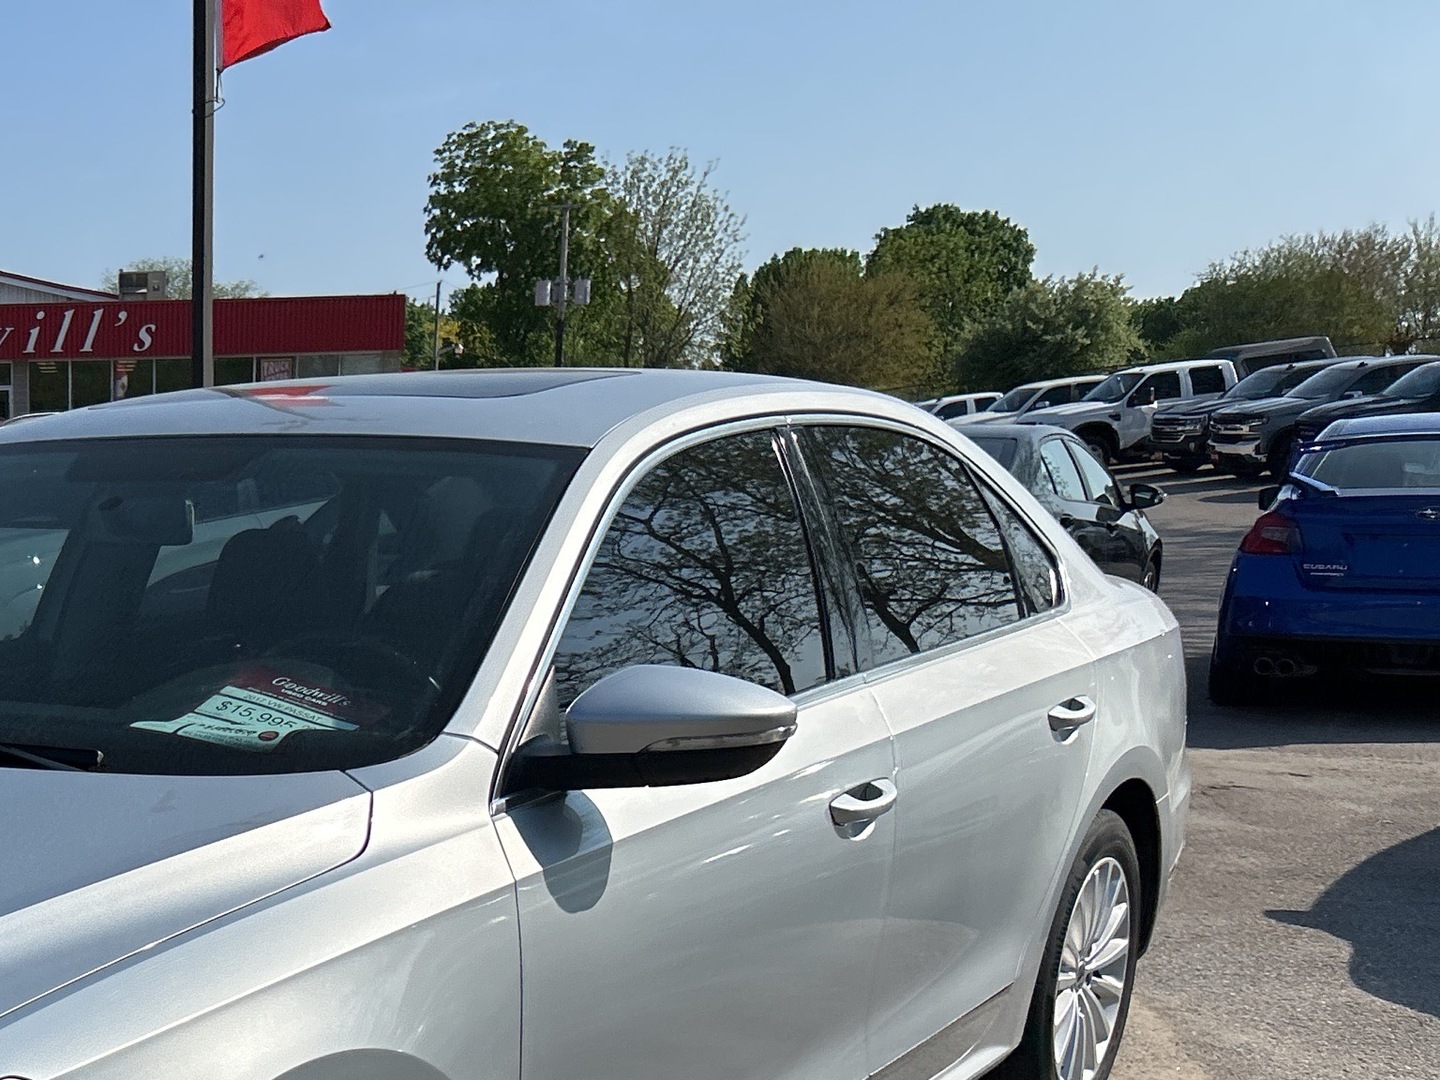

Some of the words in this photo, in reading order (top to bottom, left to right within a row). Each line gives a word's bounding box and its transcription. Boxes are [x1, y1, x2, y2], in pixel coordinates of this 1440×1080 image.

[271, 676, 352, 707] Goodwill's
[304, 695, 328, 707] CARS
[216, 700, 298, 729] $15,995
[243, 694, 267, 704] 2017
[267, 699, 284, 711] VW
[283, 705, 324, 722] PASSAT
